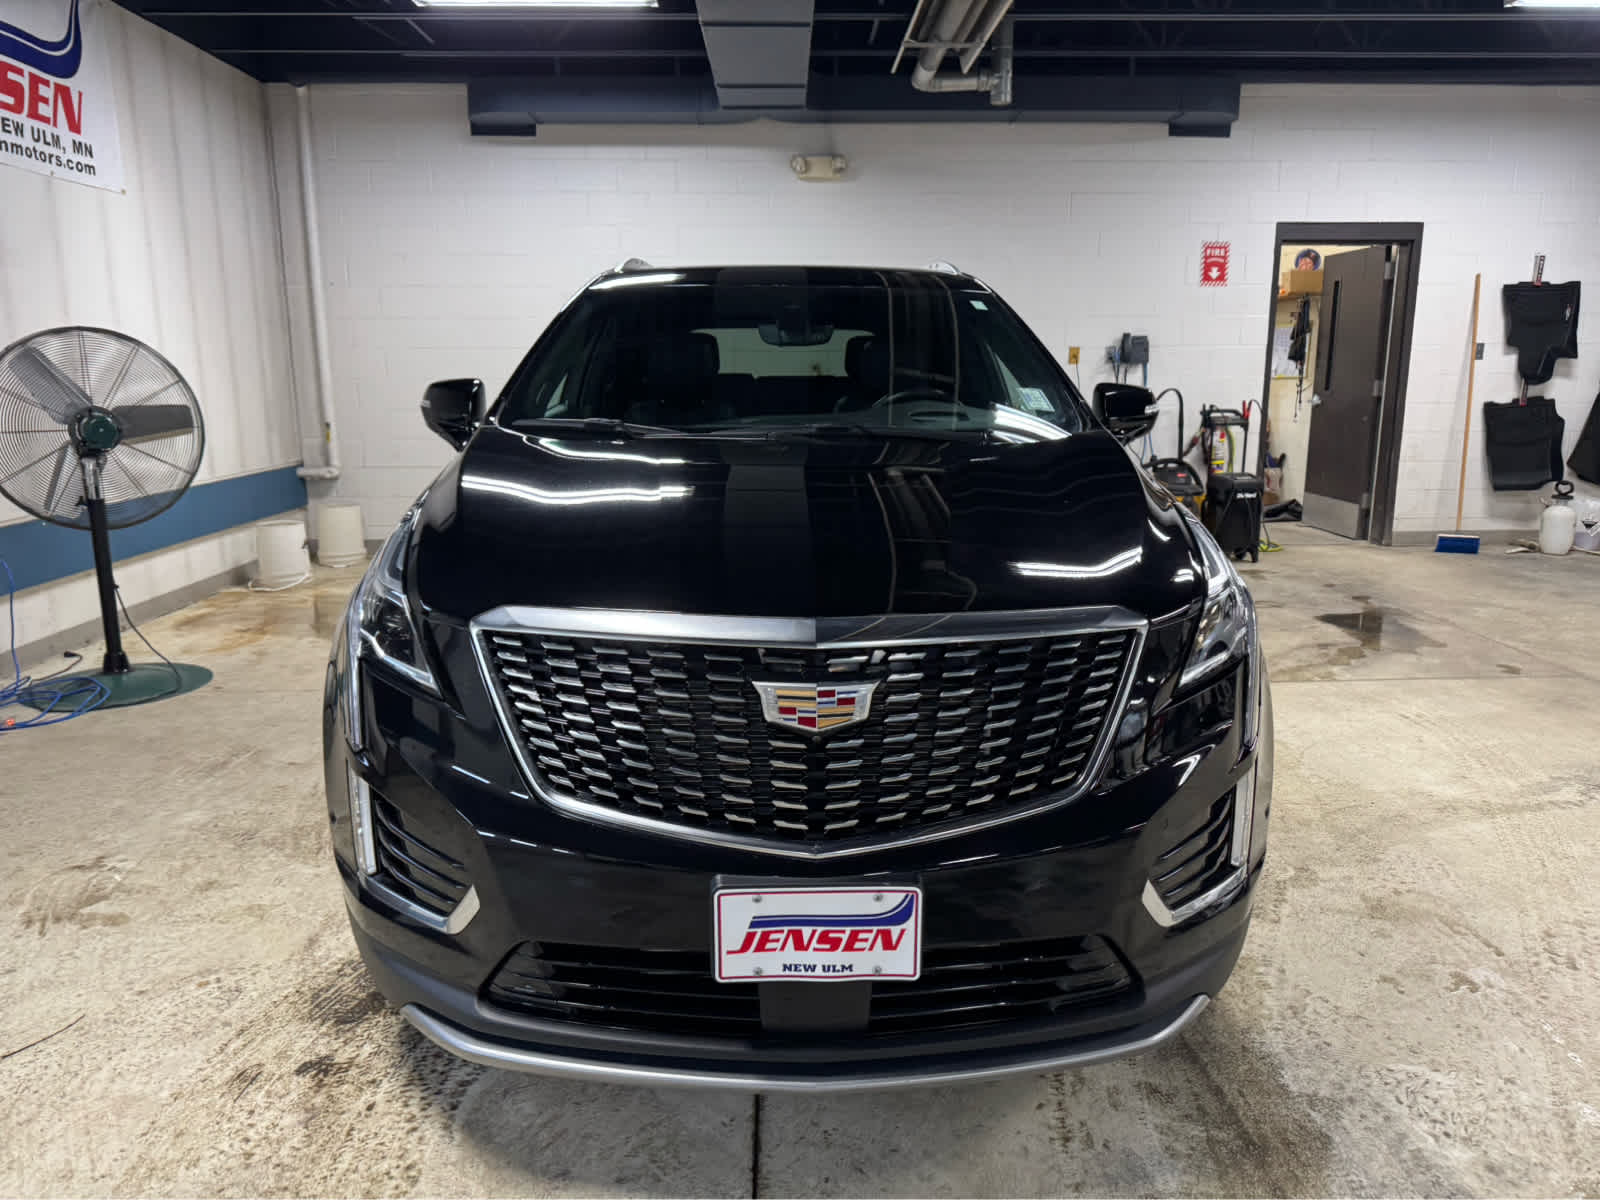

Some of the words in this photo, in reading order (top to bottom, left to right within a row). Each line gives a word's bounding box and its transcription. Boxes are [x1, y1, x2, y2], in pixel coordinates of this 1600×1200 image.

[31, 125, 66, 154] ULM,
[72, 138, 94, 158] MN
[1206, 248, 1225, 256] FIRE
[726, 928, 906, 955] JENSEN
[782, 963, 817, 973] NEW
[821, 963, 853, 973] ULM
